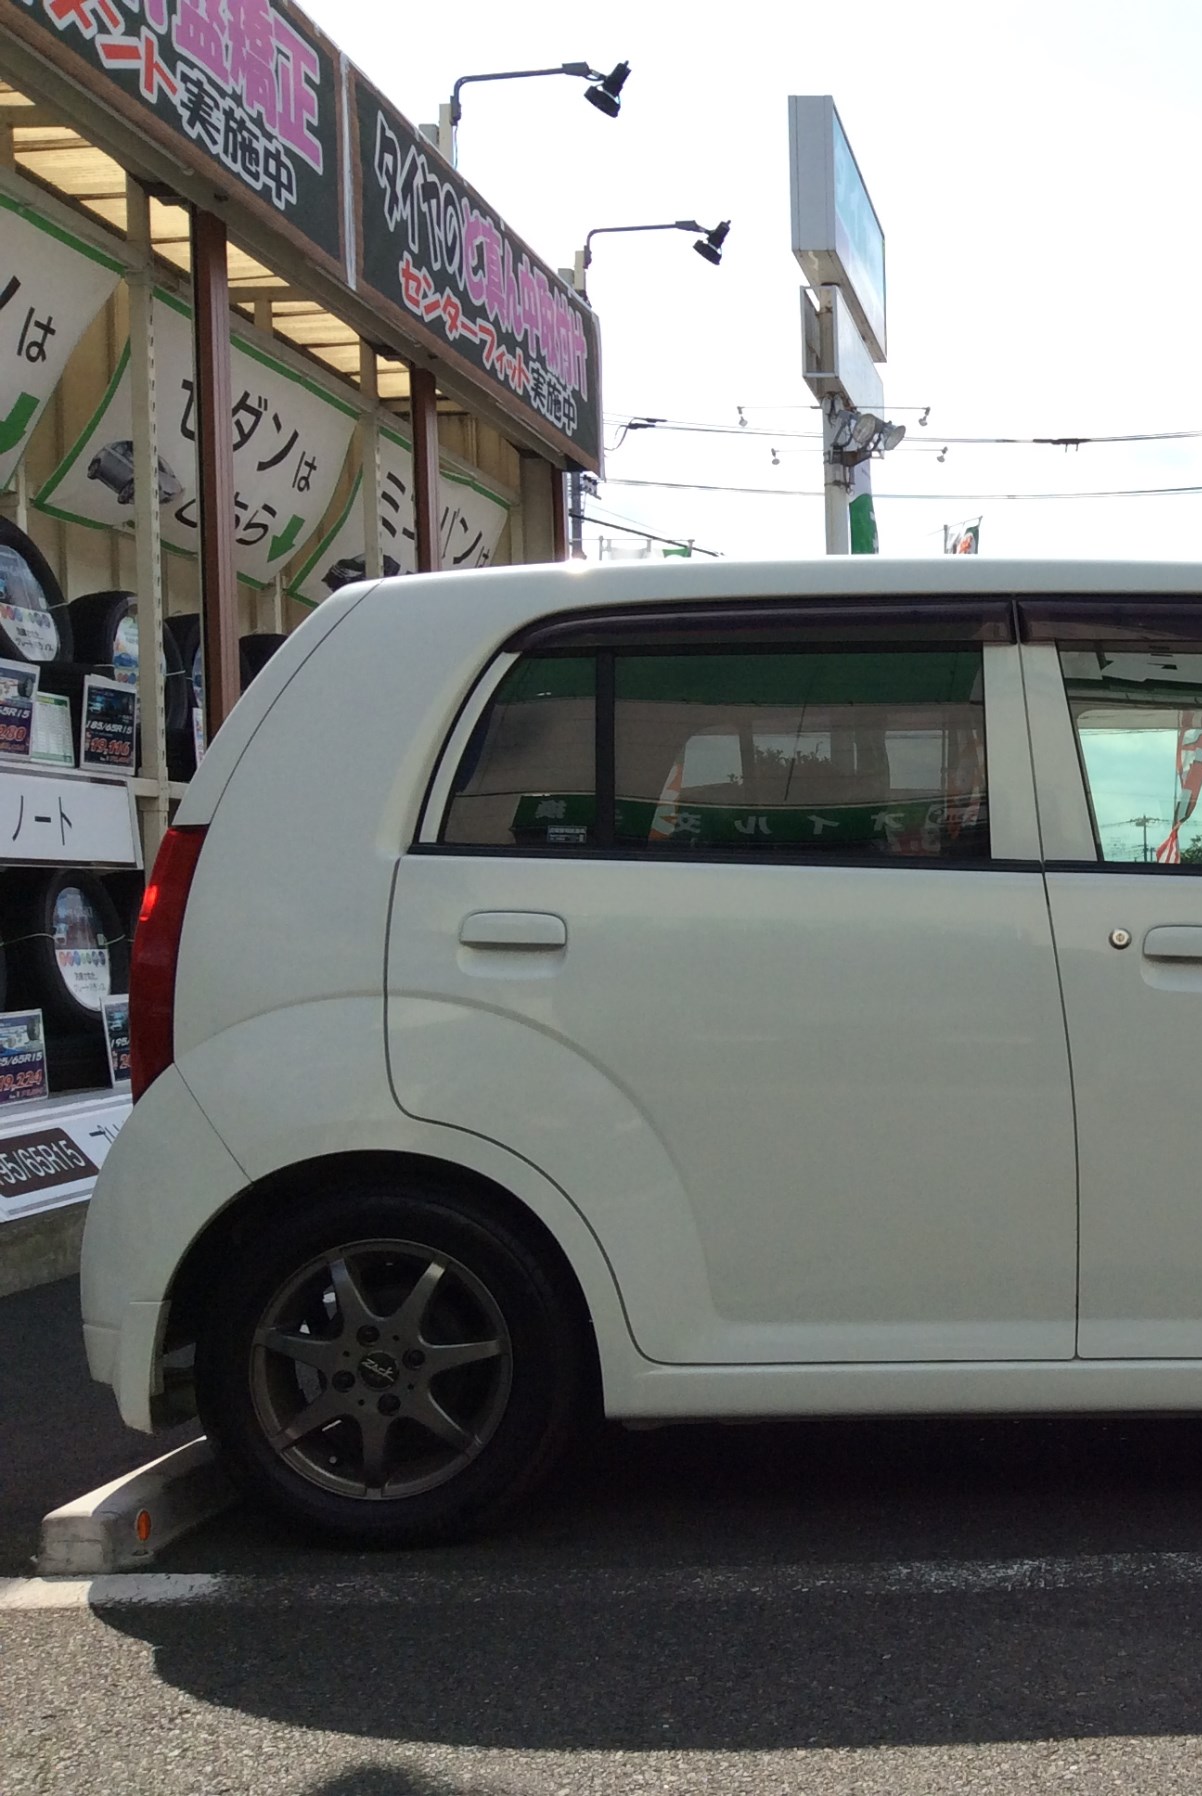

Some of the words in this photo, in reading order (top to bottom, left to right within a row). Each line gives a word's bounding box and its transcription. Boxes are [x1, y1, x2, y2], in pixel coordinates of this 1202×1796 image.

[399, 251, 577, 436] センターフィット実施中
